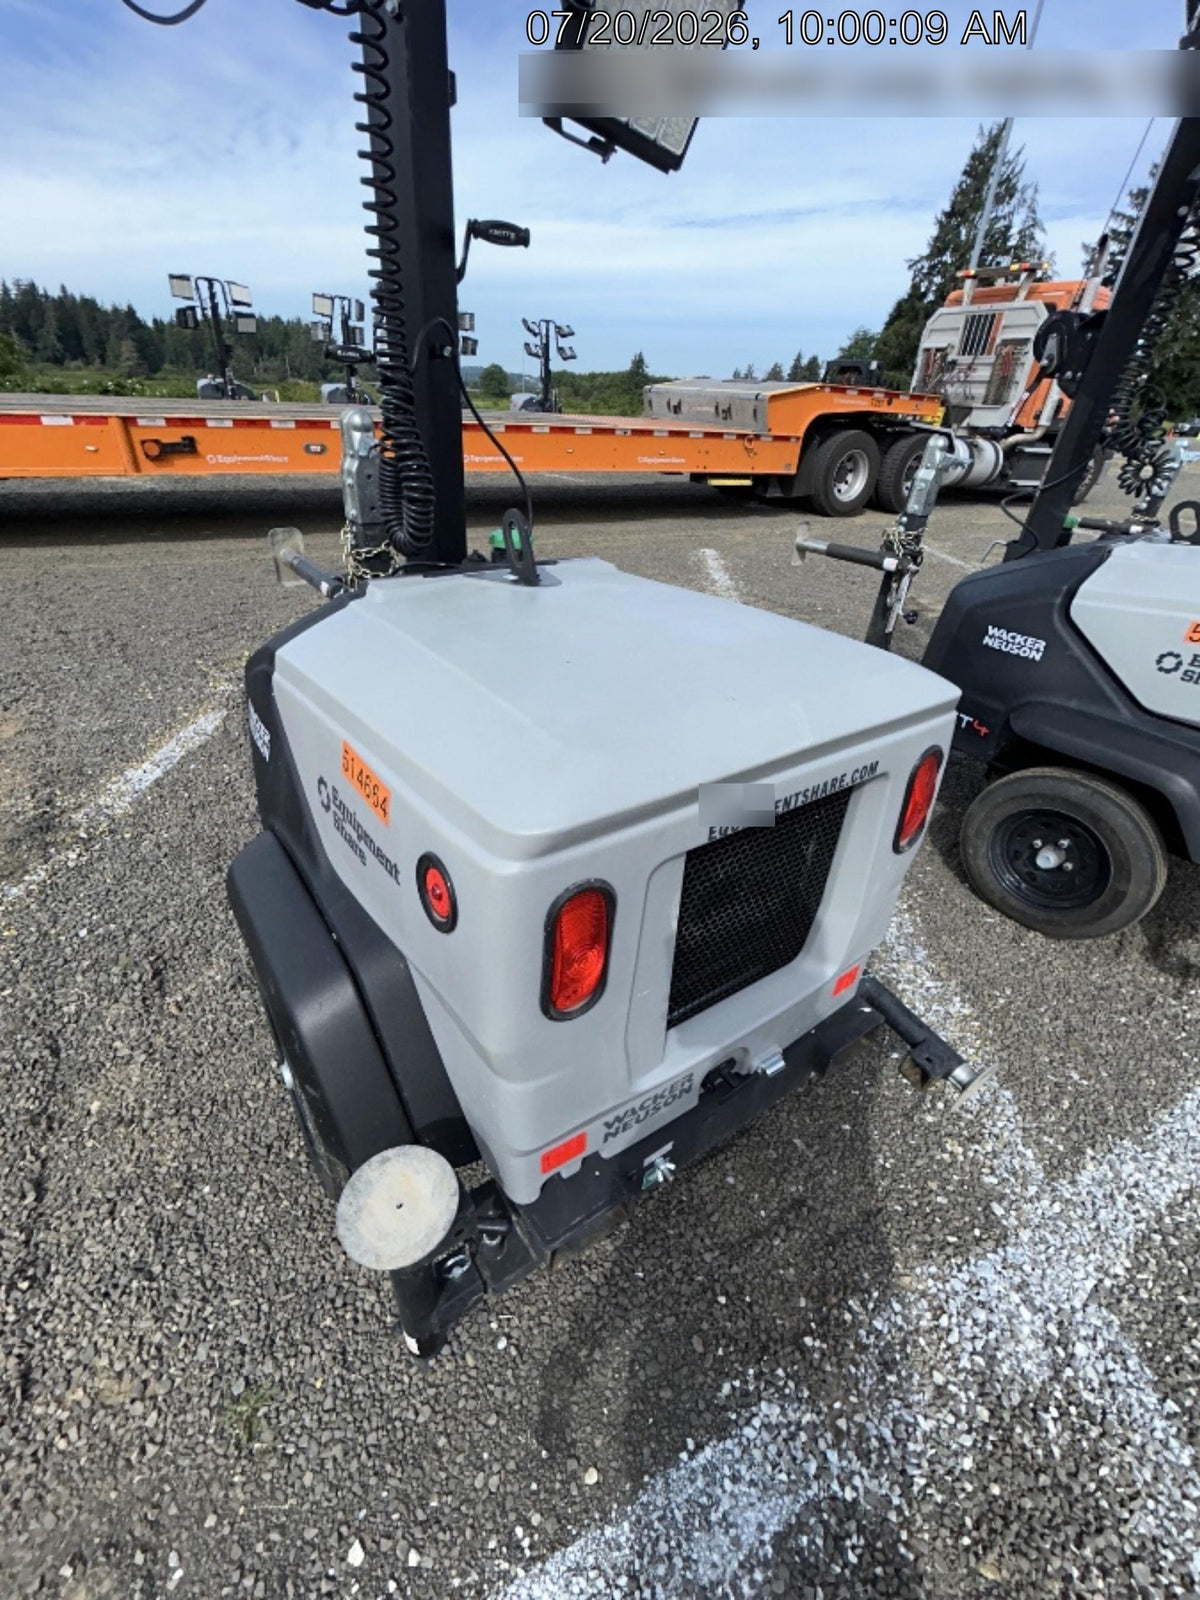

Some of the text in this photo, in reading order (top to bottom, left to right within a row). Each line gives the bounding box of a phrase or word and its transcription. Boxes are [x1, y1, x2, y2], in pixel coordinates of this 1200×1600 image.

[982, 635, 1043, 662] NEUSON
[988, 625, 1046, 652] WACKER
[332, 784, 400, 886] Equipment
[332, 810, 367, 867] Share
[602, 1083, 692, 1144] NEUSON
[603, 1073, 694, 1130] WACKER
